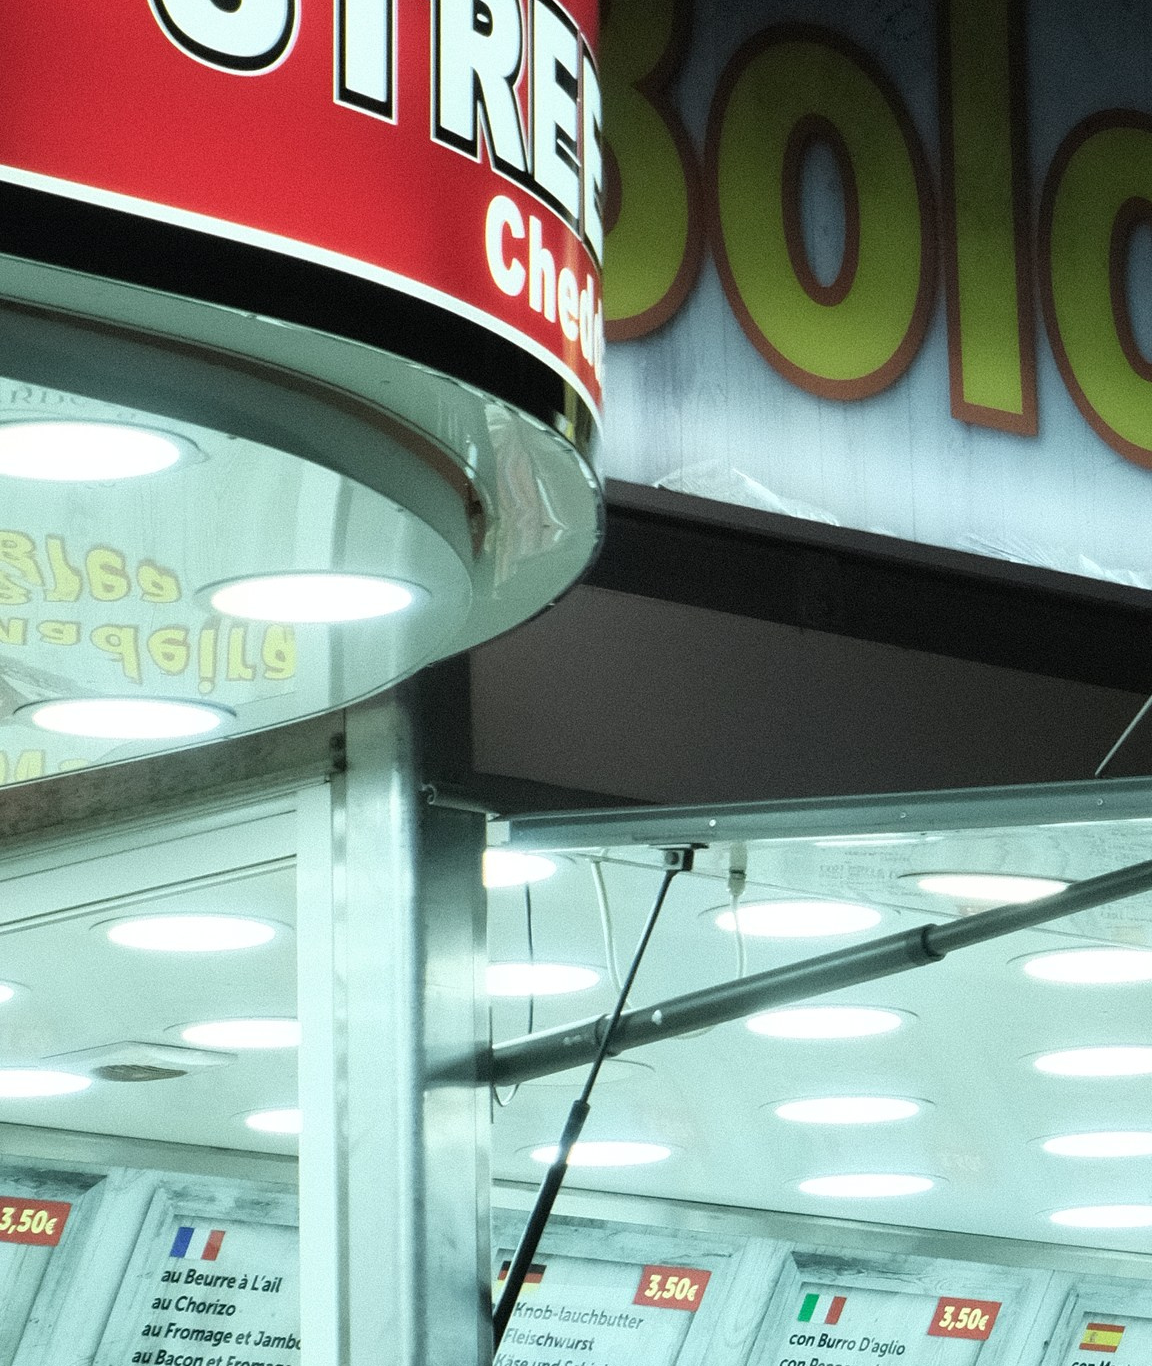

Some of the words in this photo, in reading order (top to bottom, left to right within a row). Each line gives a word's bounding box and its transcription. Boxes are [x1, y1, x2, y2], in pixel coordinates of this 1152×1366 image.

[161, 1270, 182, 1284] au
[184, 1268, 237, 1289] Beurre
[238, 1274, 249, 1290] à
[644, 1274, 699, 1302] 3,50€
[151, 1297, 173, 1310] au
[174, 1295, 237, 1316] Chorizo
[938, 1305, 990, 1331] 3,50€
[141, 1324, 163, 1337] au
[164, 1322, 233, 1347] Fromage
[235, 1331, 252, 1346] et
[503, 1327, 596, 1352] Fleischwurst
[789, 1333, 816, 1347] con
[817, 1332, 857, 1351] Burro
[858, 1336, 906, 1358] D'aglio
[131, 1350, 153, 1364] au
